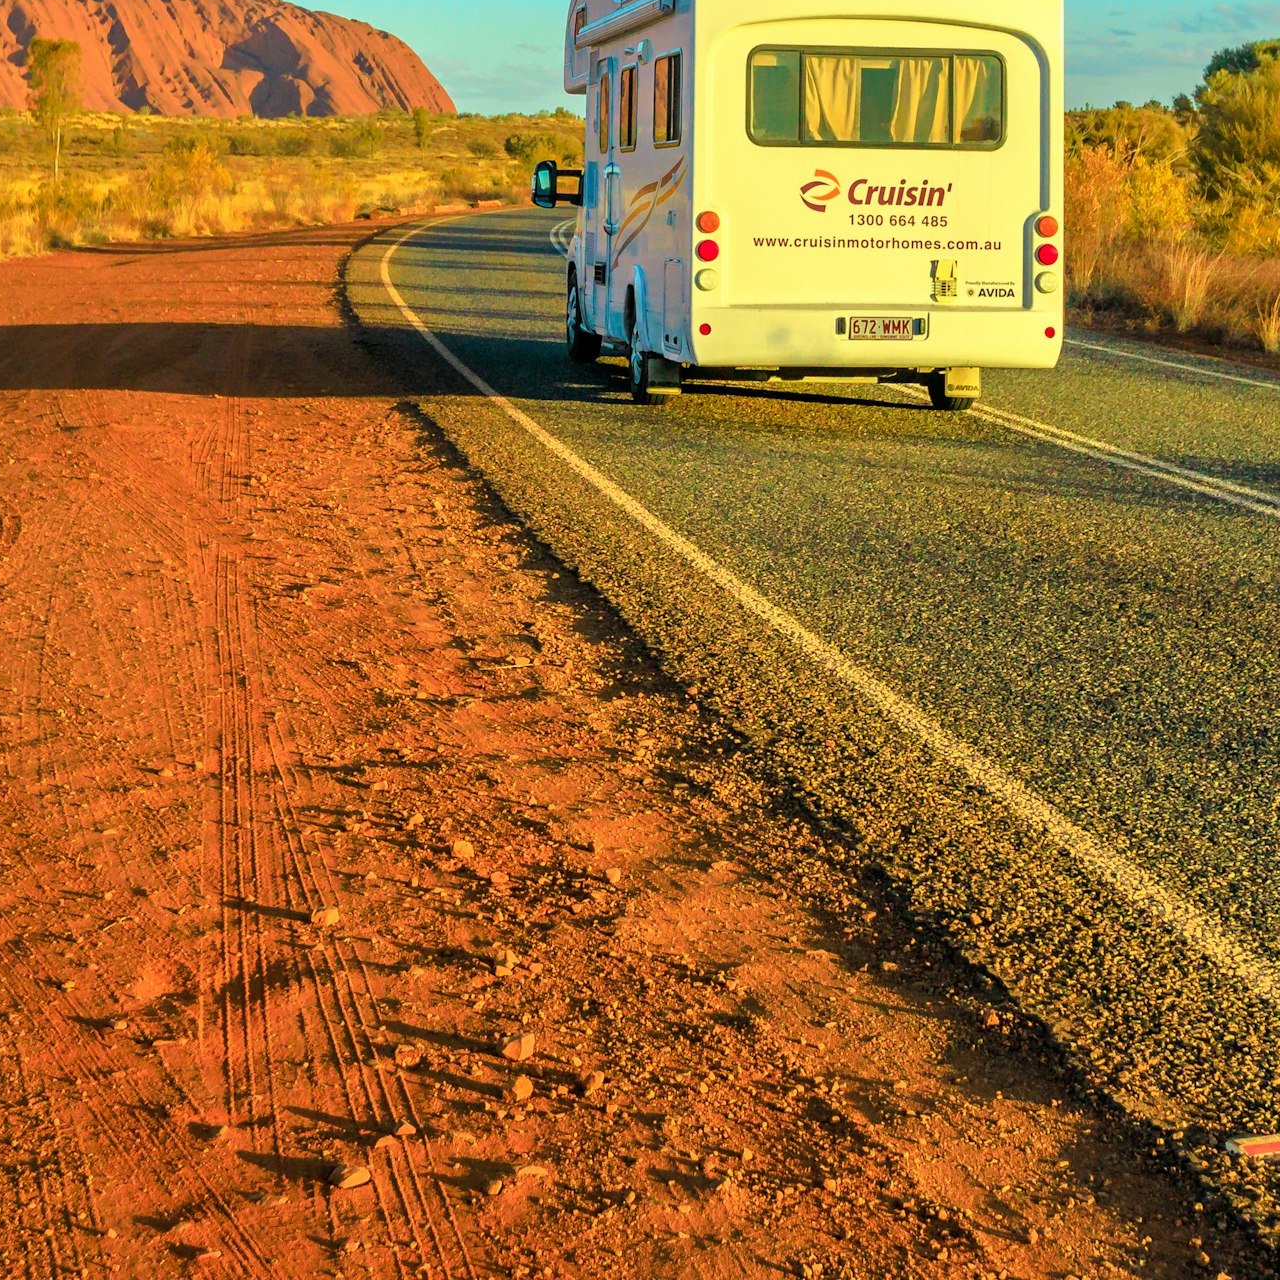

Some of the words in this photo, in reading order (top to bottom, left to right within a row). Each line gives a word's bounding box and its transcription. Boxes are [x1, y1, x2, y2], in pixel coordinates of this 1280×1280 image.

[848, 178, 952, 206] Cruisin'
[848, 214, 884, 226] 1300
[889, 215, 916, 227] 664
[921, 215, 948, 227] 485
[753, 235, 1002, 251] www.cruisinmotorhomes.com.au
[978, 288, 1015, 298] AVIDA
